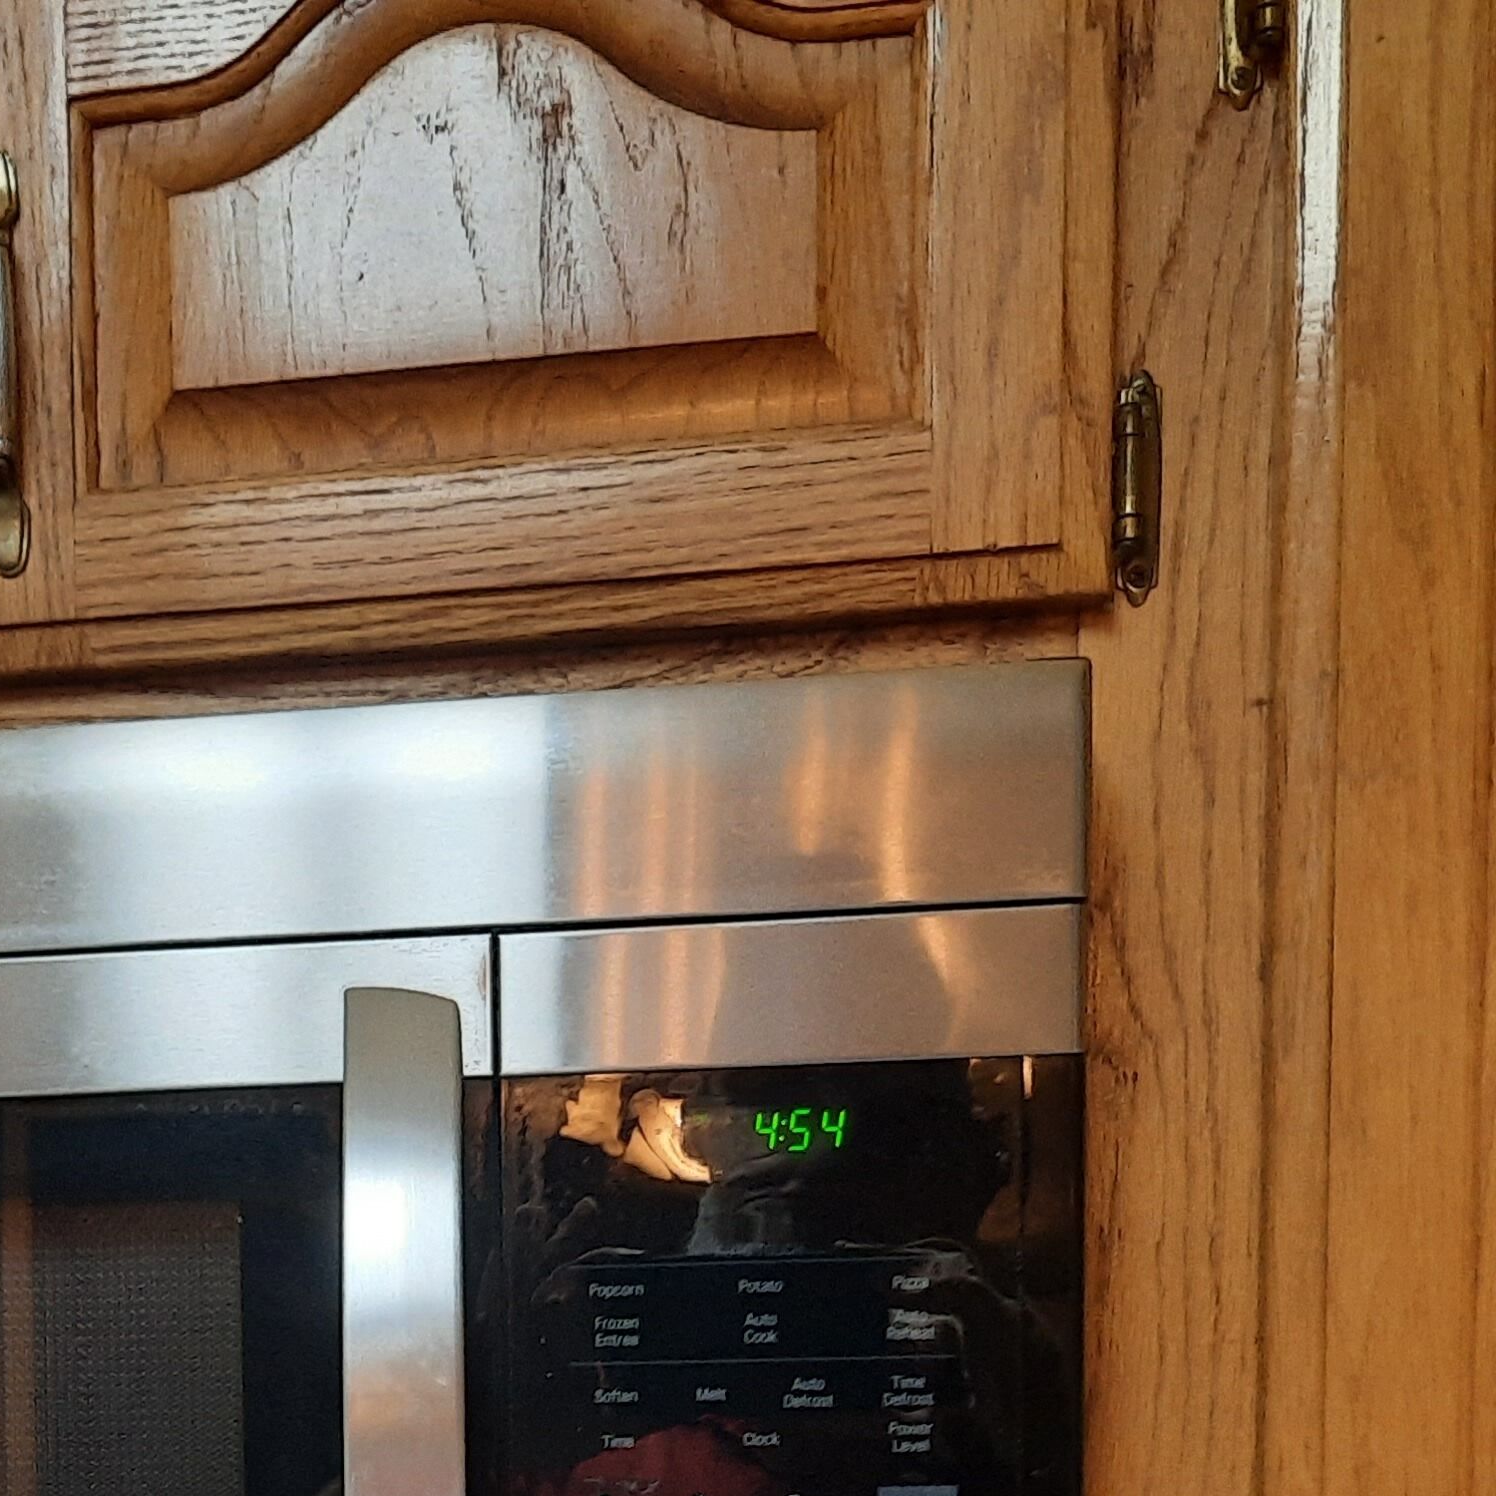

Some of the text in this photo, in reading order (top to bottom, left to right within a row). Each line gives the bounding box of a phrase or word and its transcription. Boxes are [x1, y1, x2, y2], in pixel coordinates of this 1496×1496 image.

[755, 1109, 846, 1151] 4:54
[589, 1283, 644, 1299] Popcorn
[737, 1279, 784, 1294] Potato
[594, 1316, 639, 1330] Frozen
[744, 1313, 778, 1326] Auto
[743, 1330, 779, 1344] Cook
[791, 1378, 825, 1391] Auto
[594, 1389, 639, 1404] Soften
[888, 1422, 933, 1436] Power
[743, 1432, 780, 1447] Clock
[892, 1439, 931, 1453] Level
